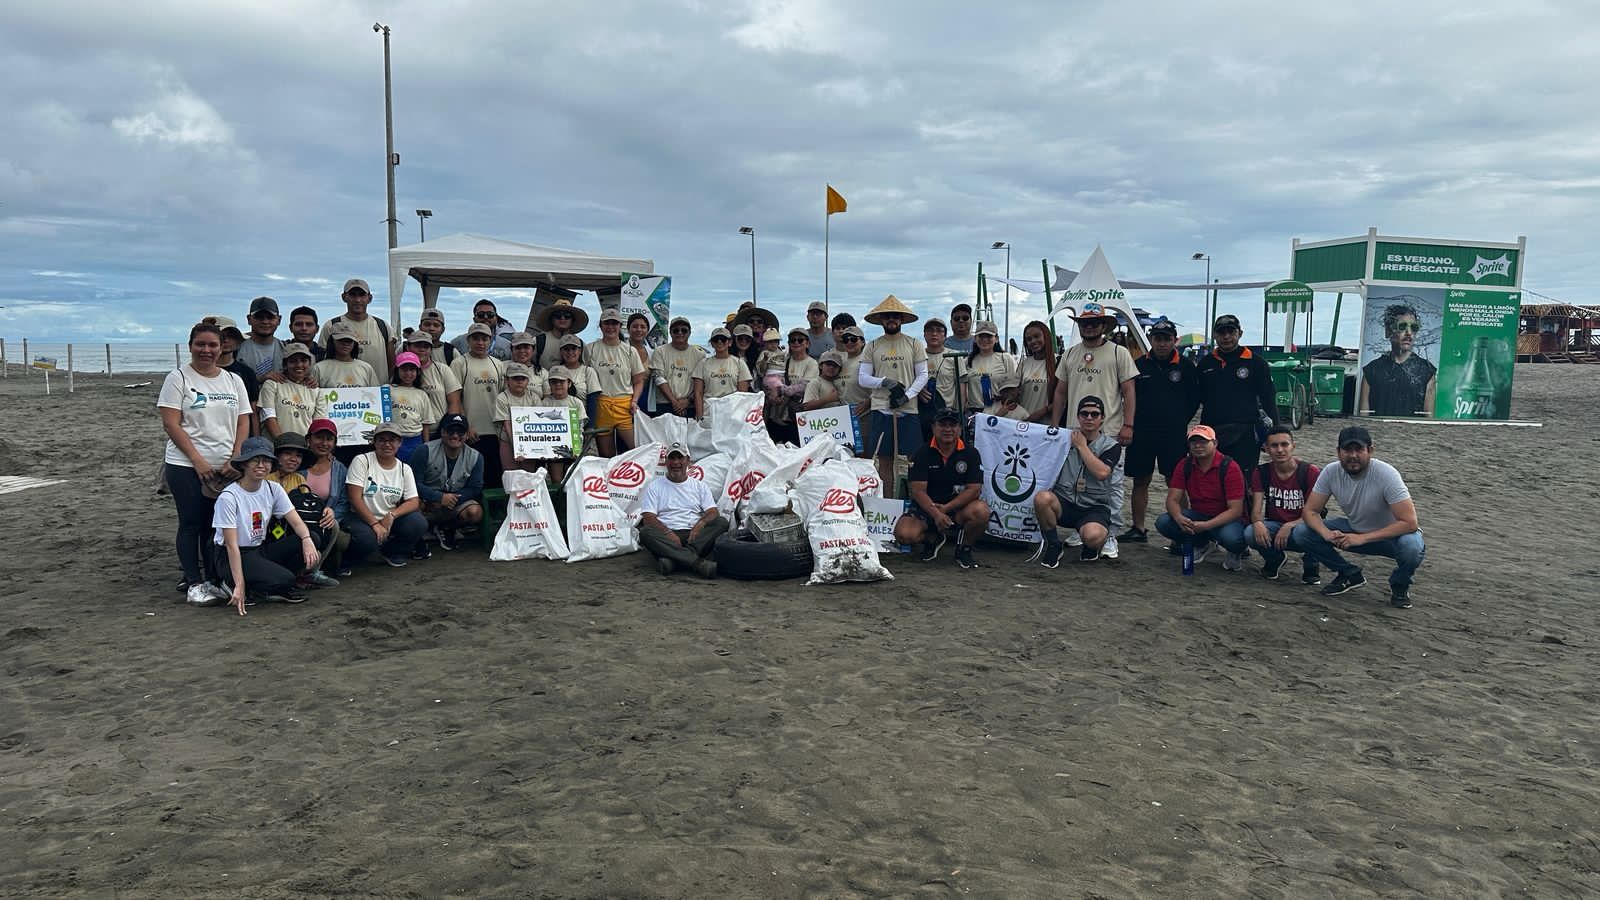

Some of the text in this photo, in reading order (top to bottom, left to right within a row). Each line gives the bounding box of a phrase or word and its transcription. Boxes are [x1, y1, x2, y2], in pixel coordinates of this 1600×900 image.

[1386, 254, 1455, 266] ES VERANO,
[1476, 261, 1505, 275] Sprite
[1061, 289, 1088, 303] Sprite
[1088, 288, 1125, 302] Sprite
[333, 401, 370, 410] cuido las
[1454, 396, 1491, 419] Sprit
[328, 410, 364, 420] playas y
[524, 424, 567, 432] GUARDIAN
[809, 418, 839, 431] HAGO
[1274, 488, 1304, 500] LA CASA
[864, 510, 889, 524] TEAM
[989, 510, 1038, 533] ACS
[509, 521, 532, 530] PASTA
[582, 522, 616, 532] PASTA DE
[819, 540, 843, 551] PASTA
[845, 539, 857, 548] DE
